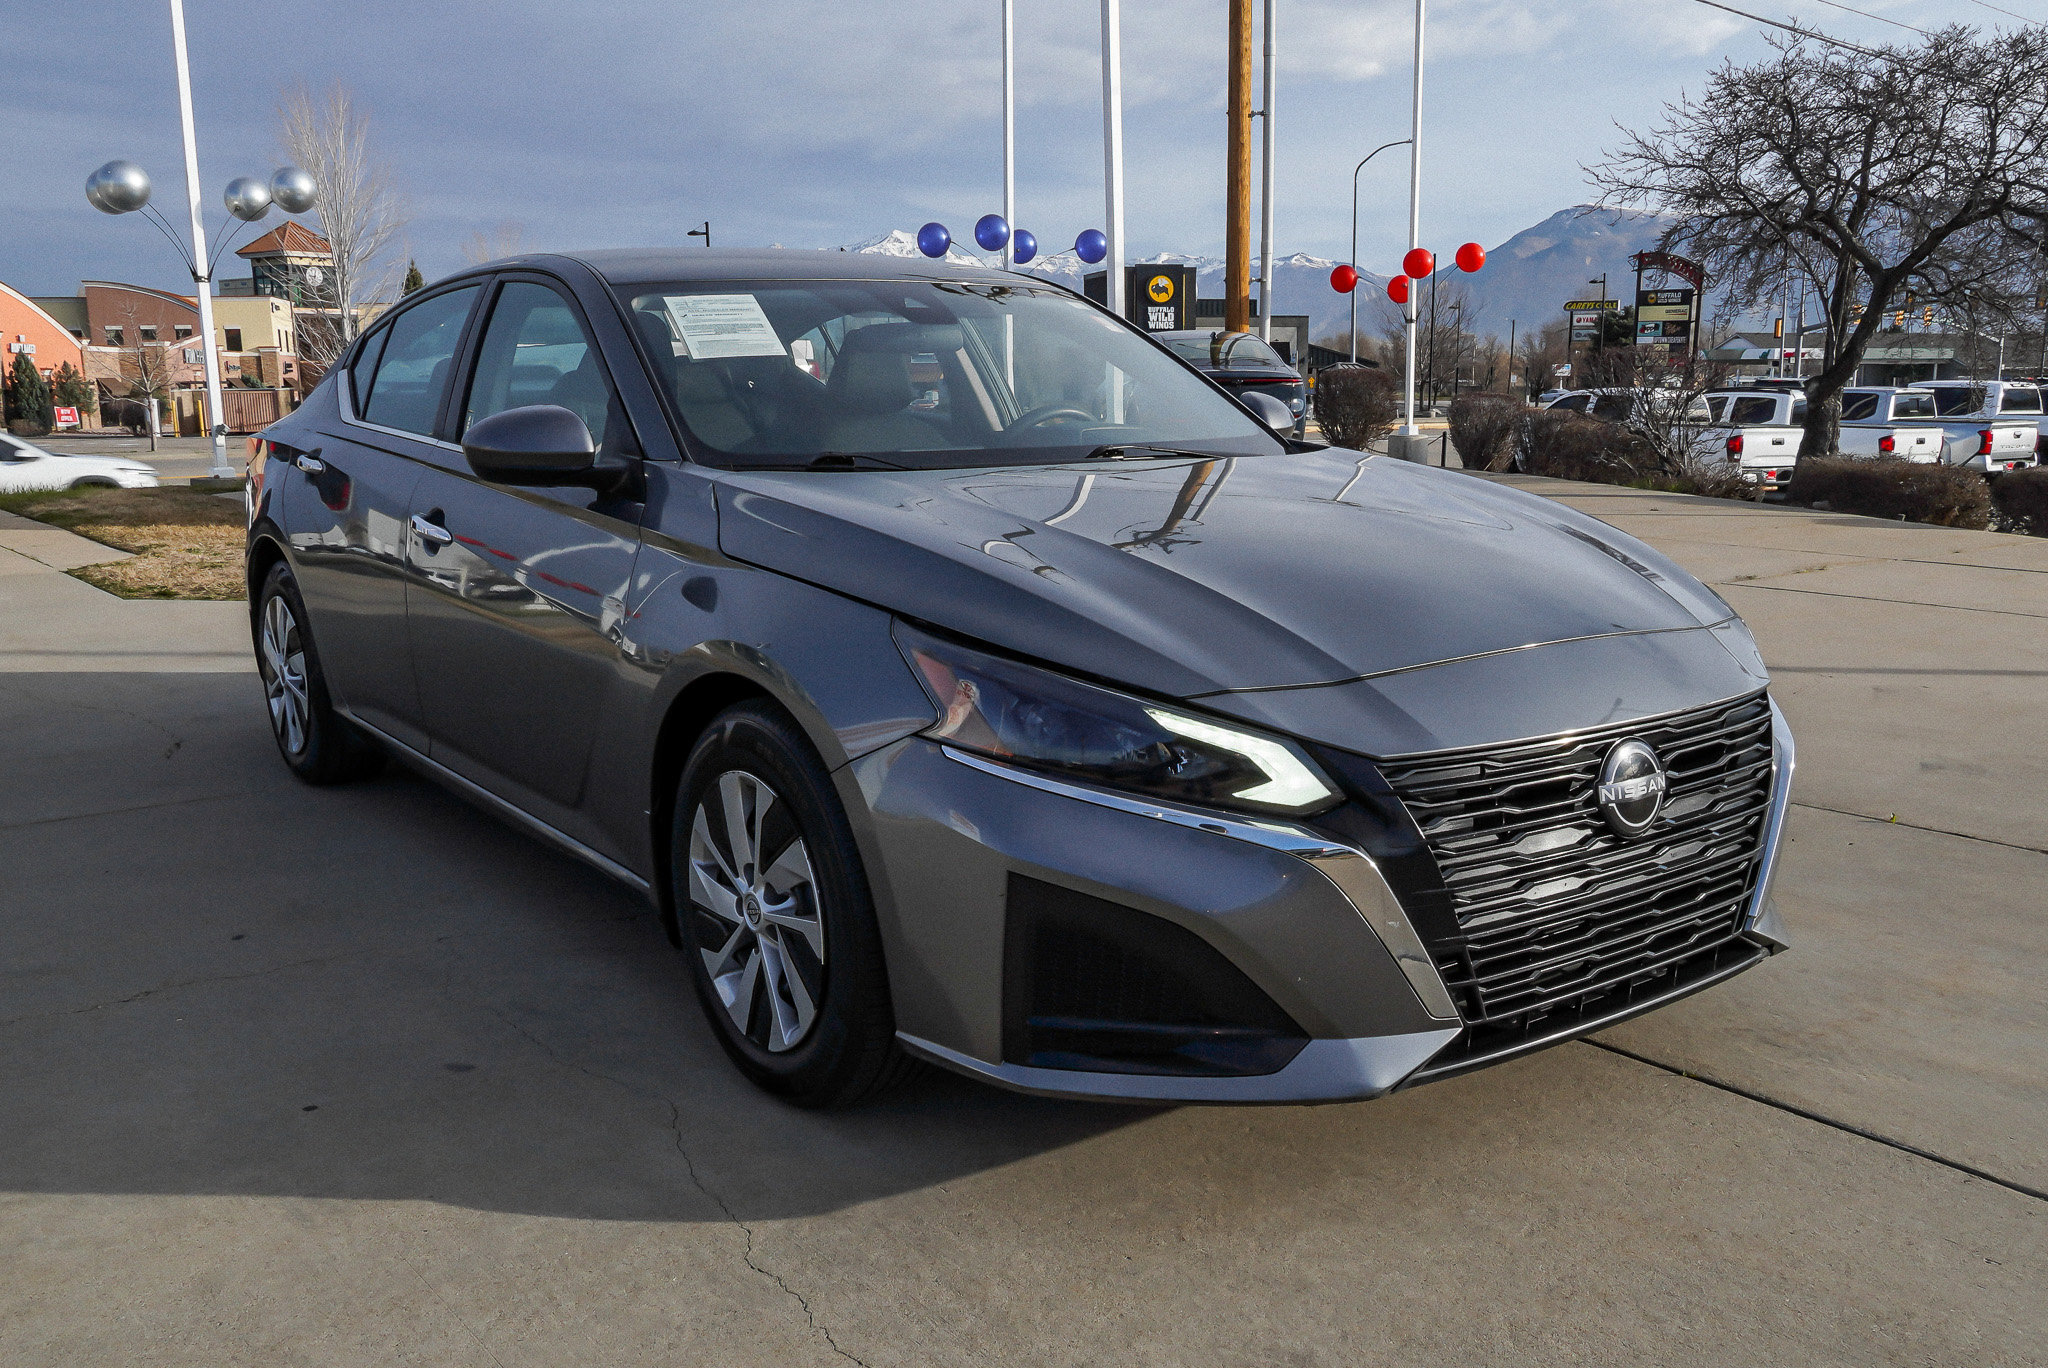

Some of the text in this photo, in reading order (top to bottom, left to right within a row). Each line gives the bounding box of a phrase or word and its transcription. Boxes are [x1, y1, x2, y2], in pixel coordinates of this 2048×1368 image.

[1148, 312, 1174, 322] WILD
[1148, 321, 1174, 329] WINGS
[1601, 773, 1666, 802] NISSAN
